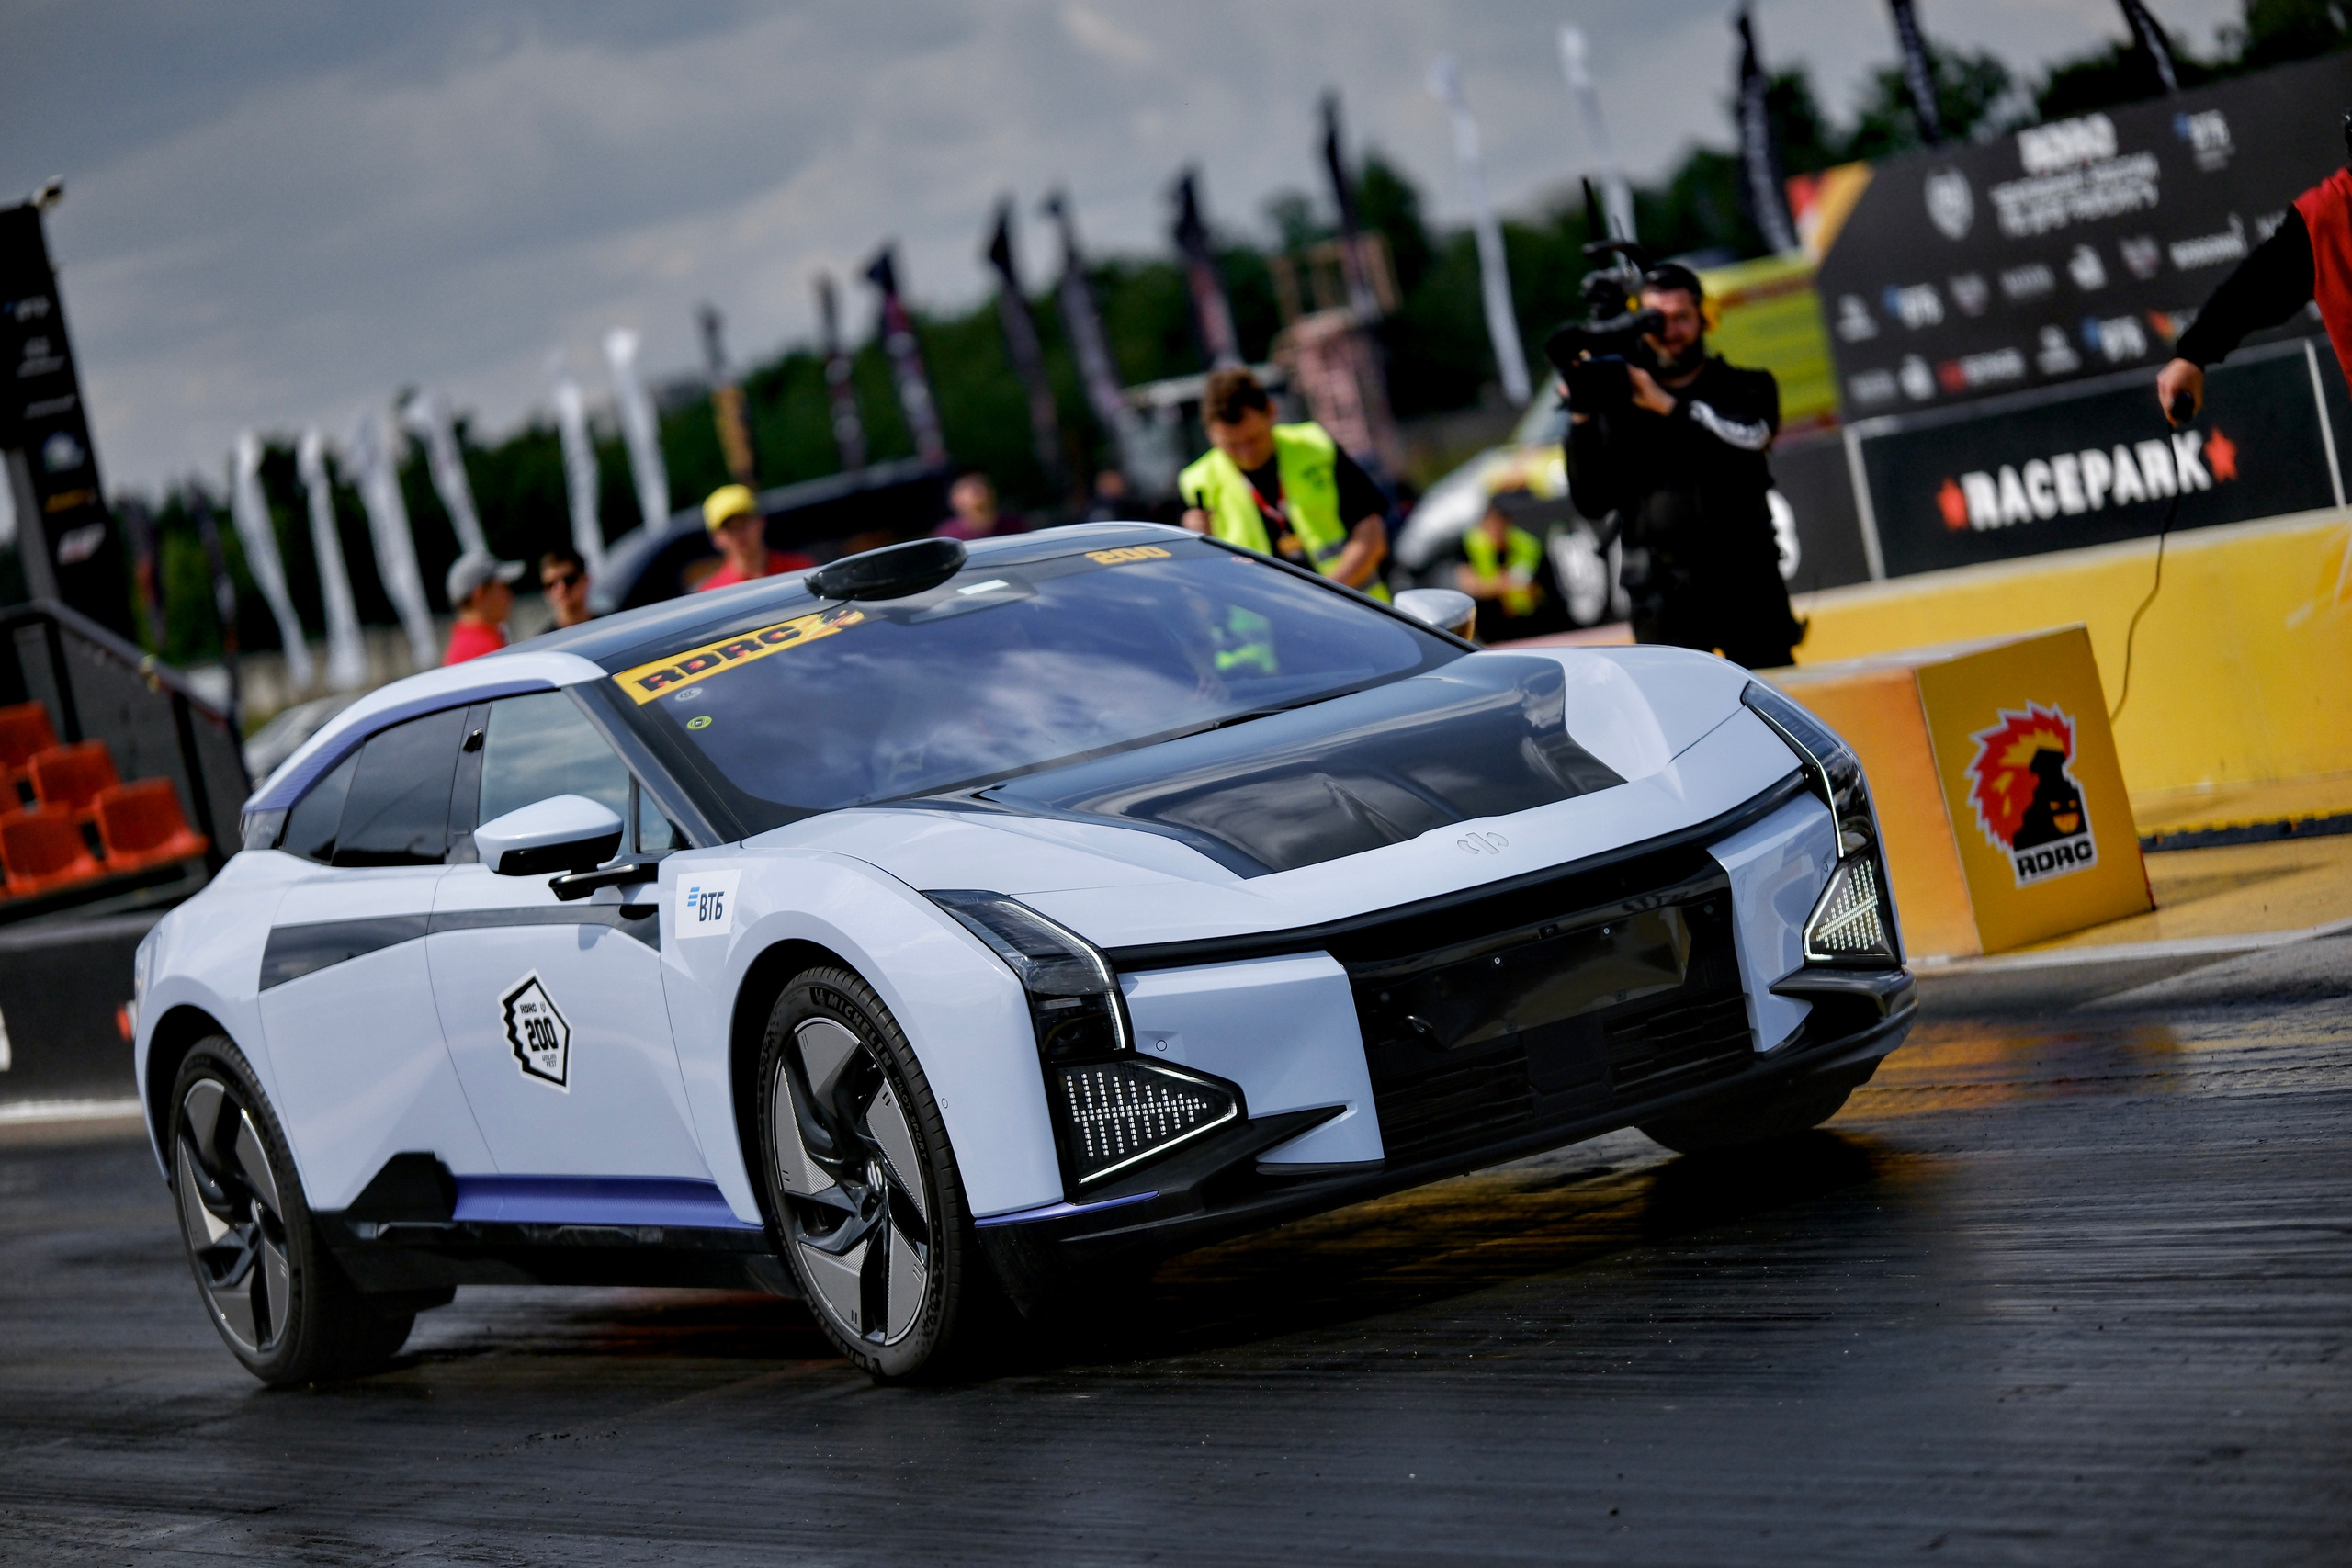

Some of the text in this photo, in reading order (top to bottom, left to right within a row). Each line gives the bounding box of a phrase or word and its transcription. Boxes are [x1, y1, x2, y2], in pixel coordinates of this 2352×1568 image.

[1960, 429, 2212, 532] RACEPARK
[1084, 546, 1172, 565] 200
[632, 626, 803, 693] RDRC
[2017, 840, 2093, 879] RDRC
[699, 891, 725, 922] ВТБ
[525, 1017, 559, 1051] 200
[828, 993, 893, 1066] MICHELIN
[894, 1076, 912, 1111] PILOT
[910, 1115, 928, 1160] SPORT
